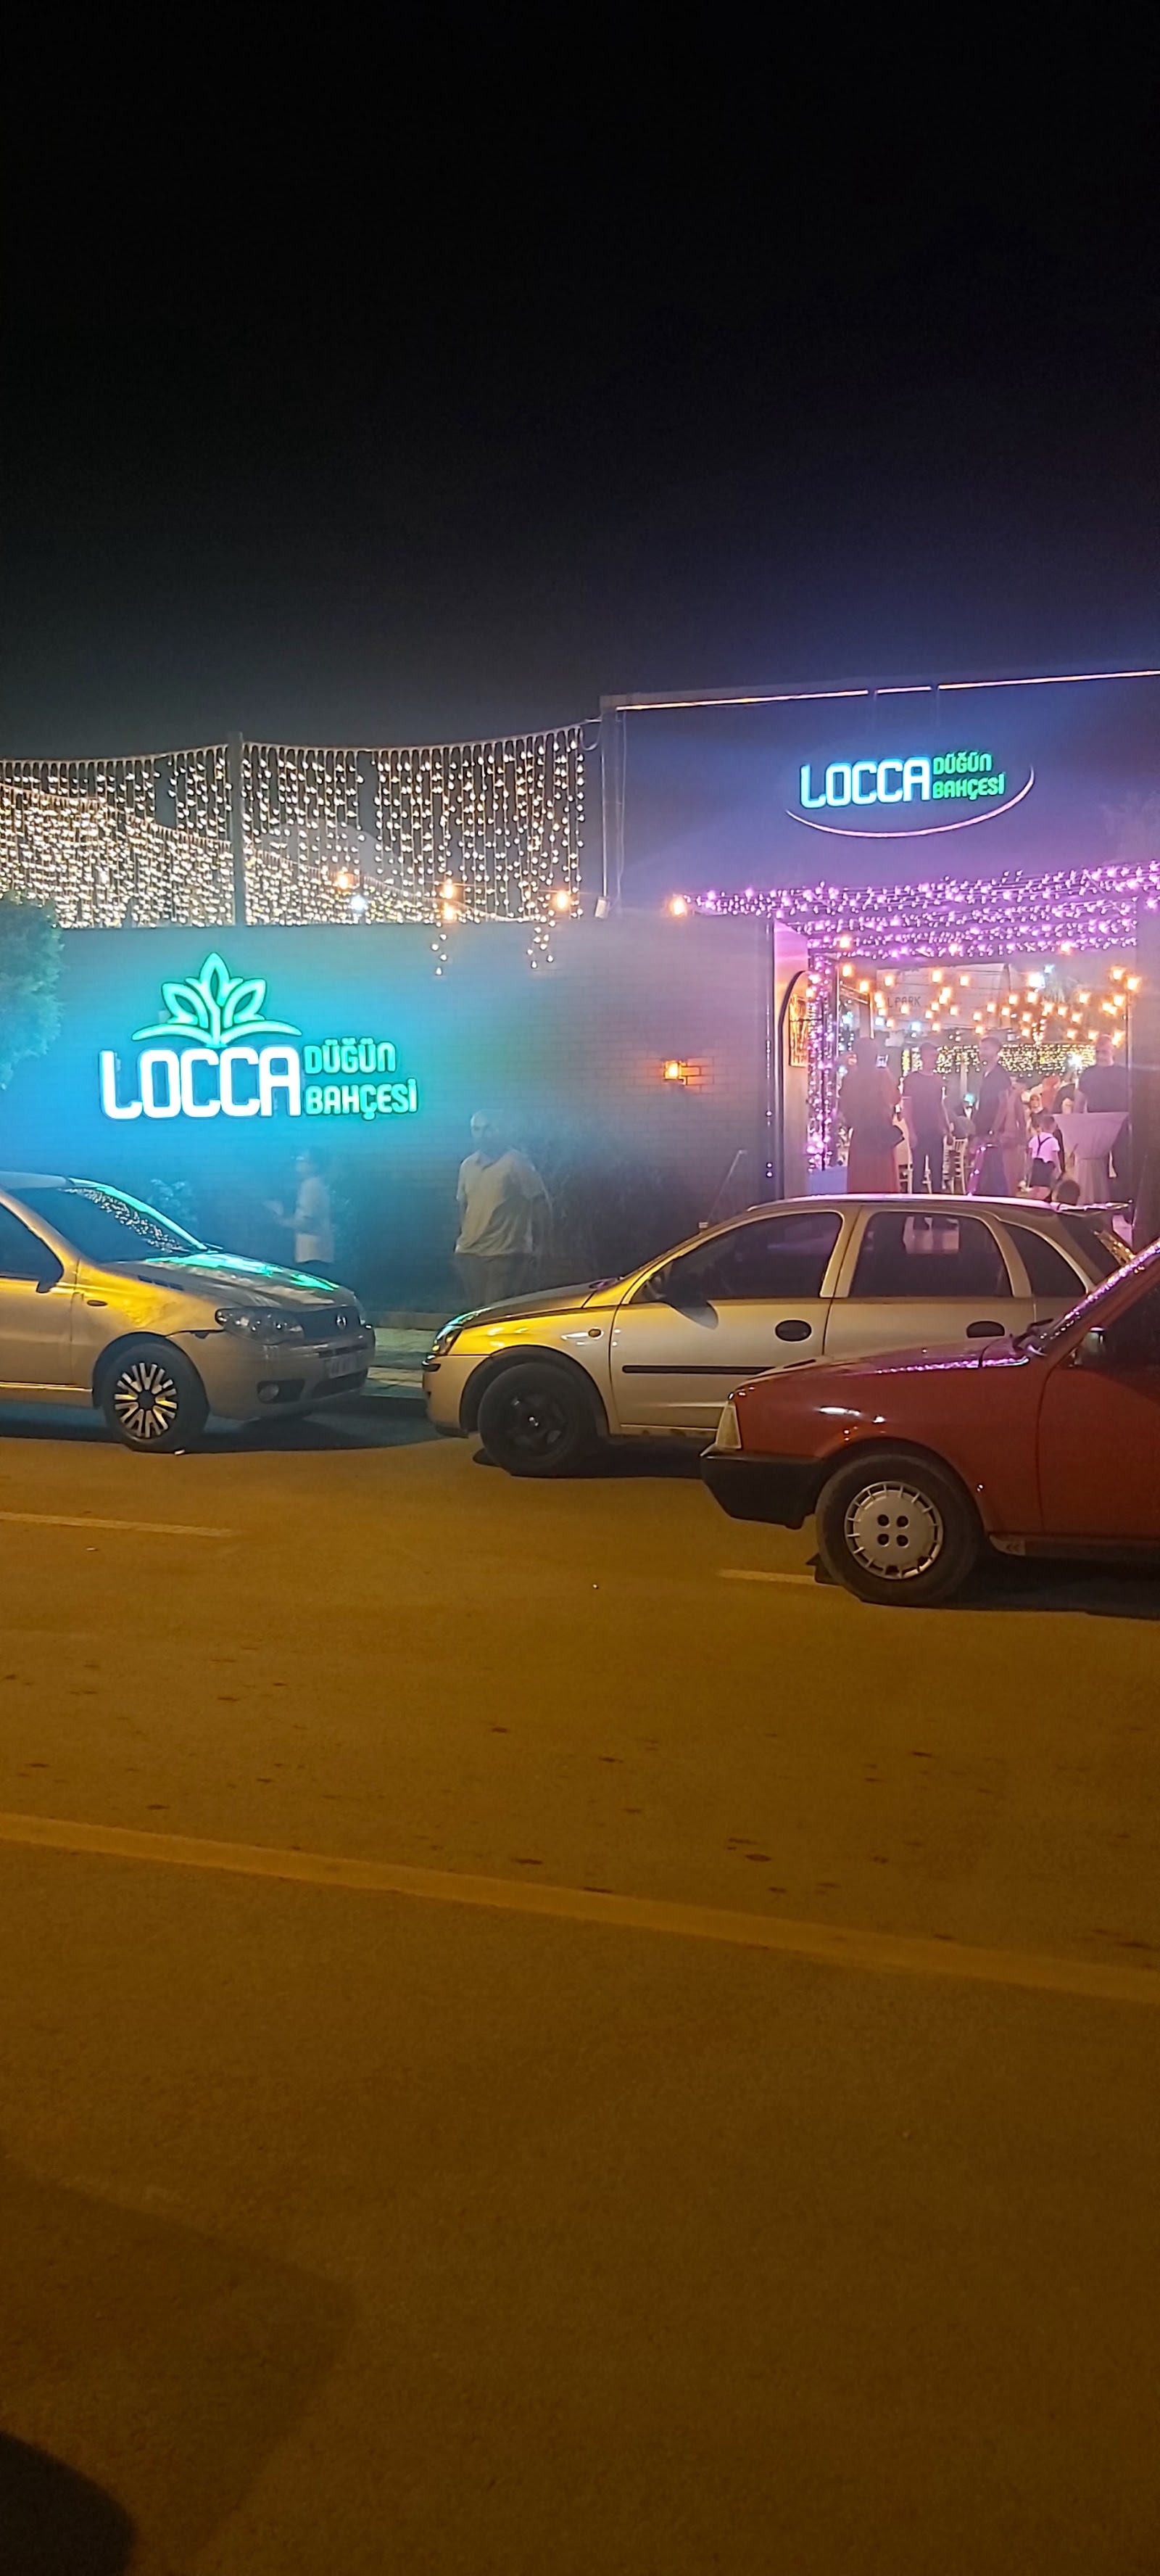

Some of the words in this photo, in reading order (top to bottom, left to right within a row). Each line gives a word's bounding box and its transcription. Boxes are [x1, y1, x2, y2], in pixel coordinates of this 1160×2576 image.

[800, 756, 931, 809] LOCCA
[933, 751, 993, 775] DÜĞÜN
[932, 772, 1006, 801] BAHÇESİ
[304, 1037, 396, 1075] DÜĞÜN
[99, 1045, 302, 1120] LOCCA
[304, 1078, 418, 1121] BAHÇESİ
